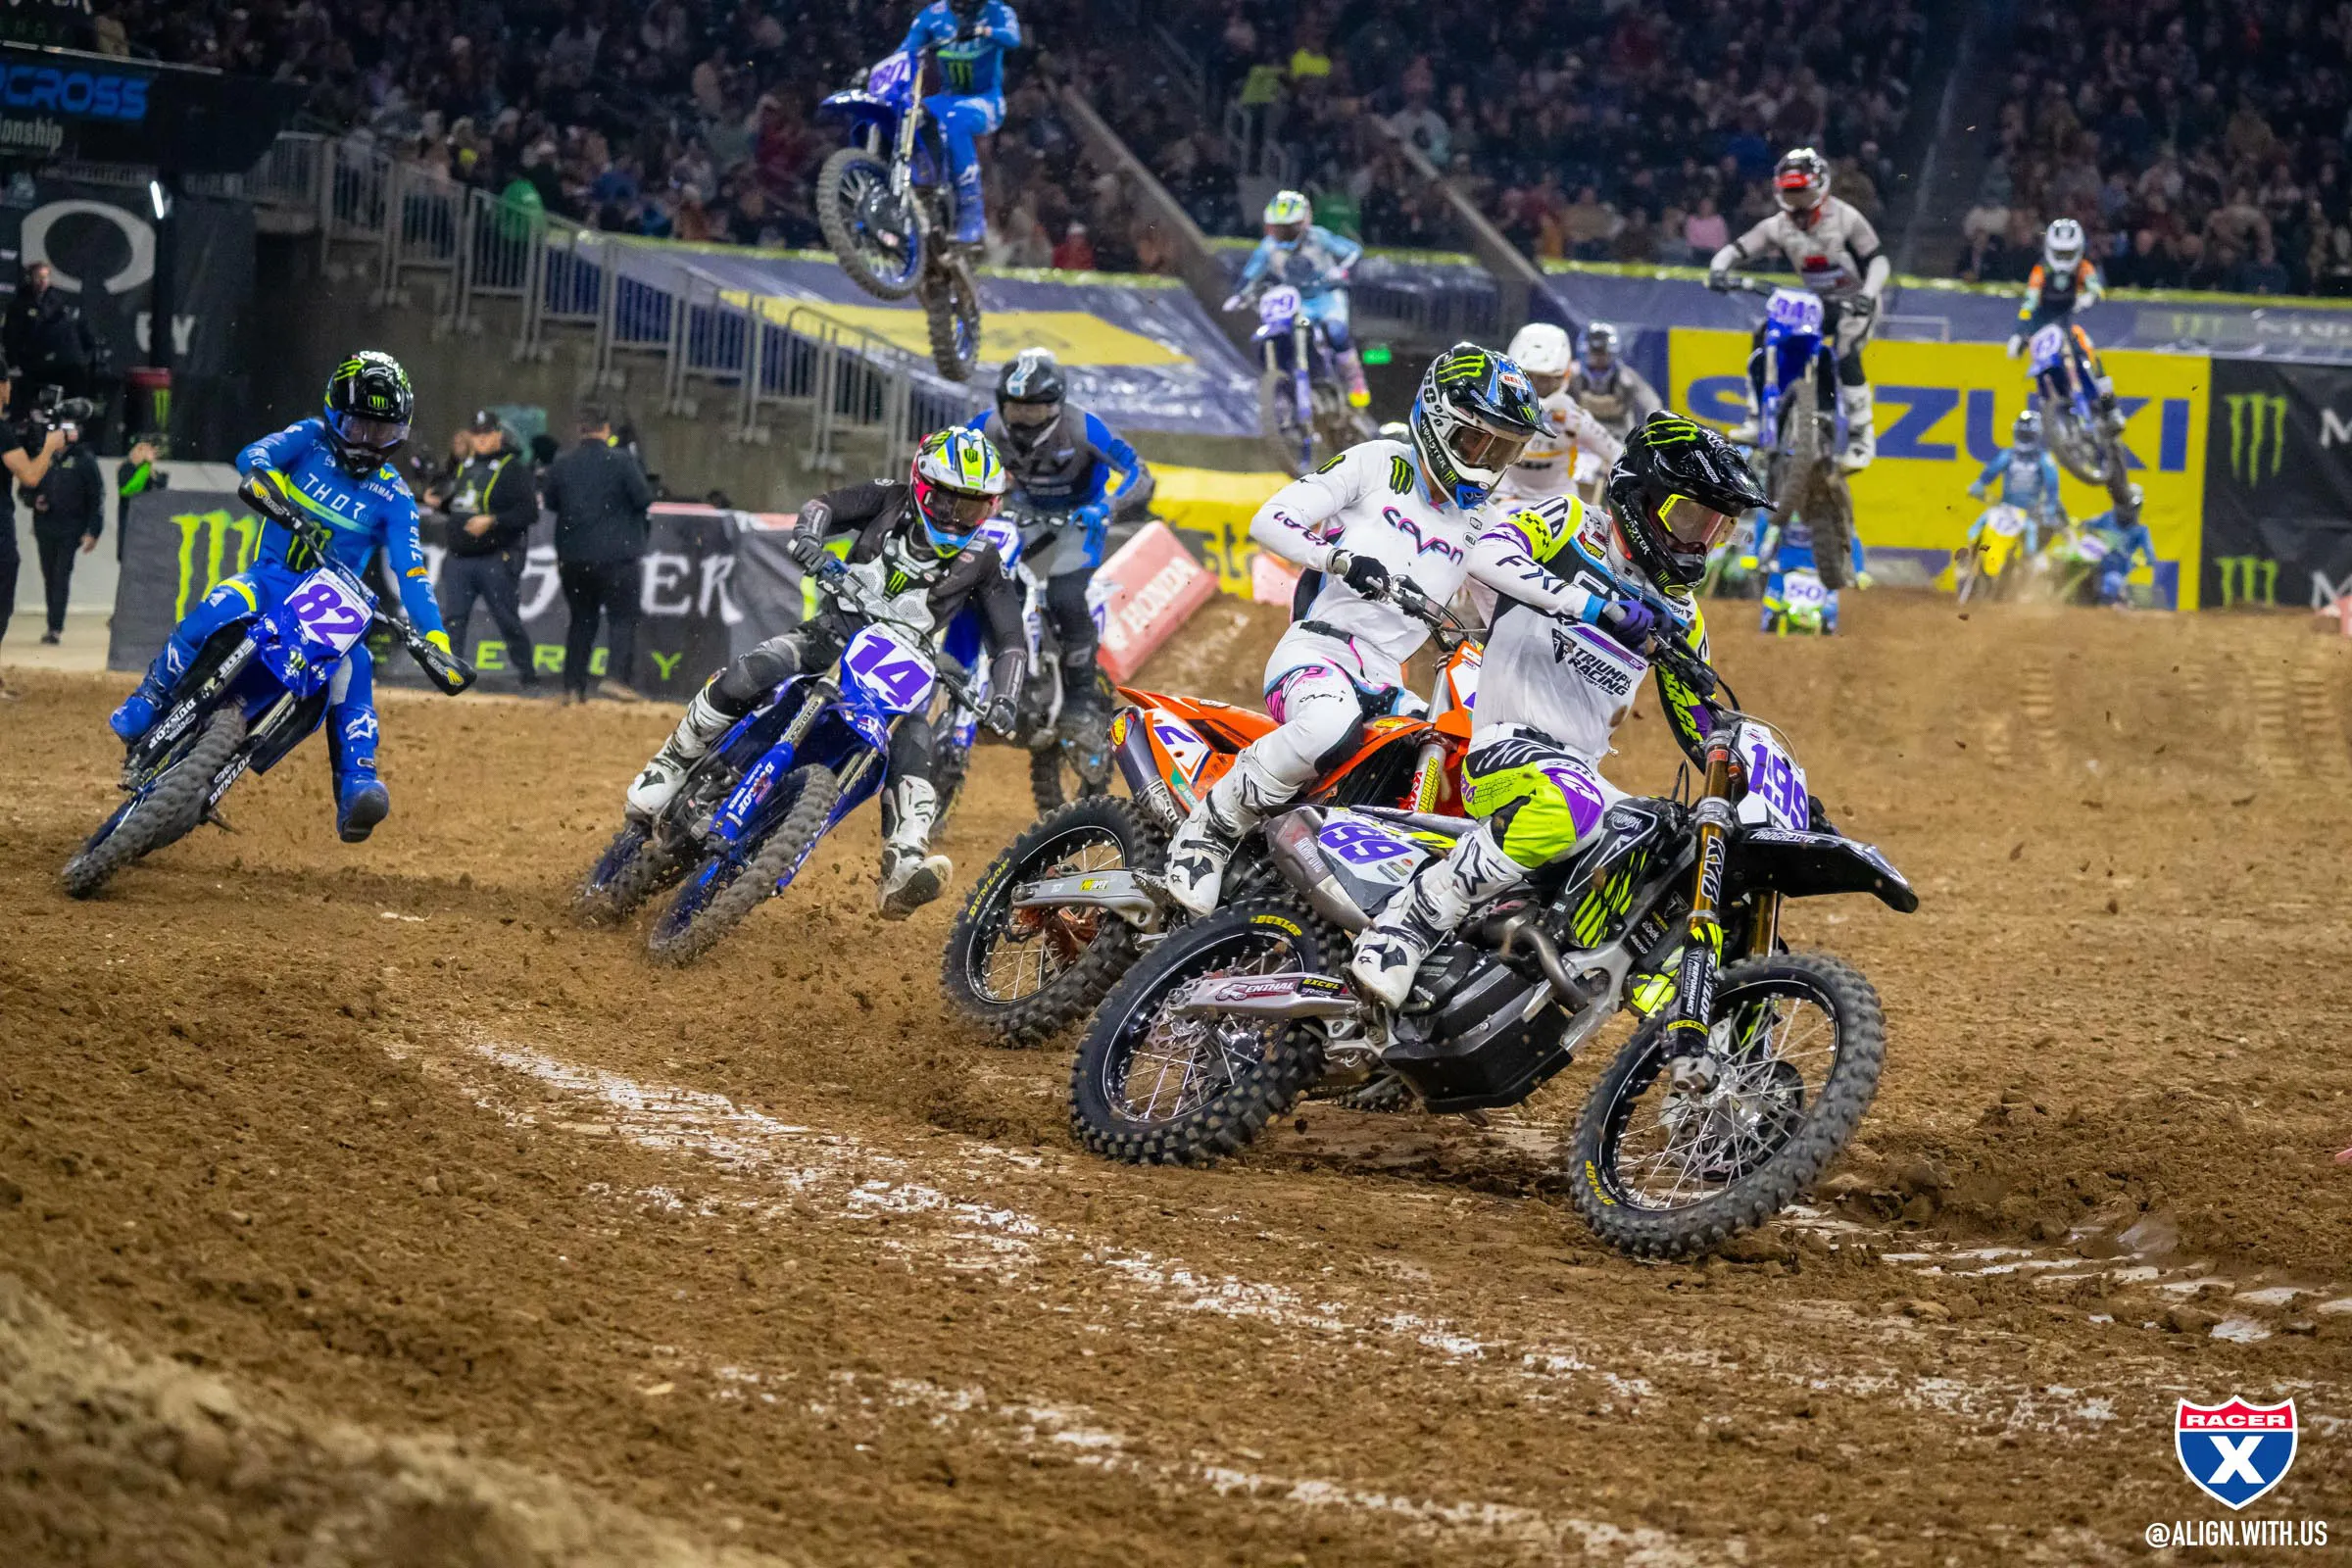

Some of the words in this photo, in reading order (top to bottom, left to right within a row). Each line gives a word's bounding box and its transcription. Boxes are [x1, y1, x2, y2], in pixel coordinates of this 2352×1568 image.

[0, 64, 148, 120] CROSS
[0, 112, 63, 155] onship
[1503, 374, 1524, 387] BELL
[1688, 373, 2189, 472] SZUKI
[290, 583, 366, 648] 82
[850, 634, 932, 709] 14
[1568, 658, 1630, 697] RACING
[1573, 647, 1633, 689] TRIUMPH
[149, 697, 196, 750] DUNLOP
[1748, 743, 1809, 831] 199
[1607, 811, 1644, 829] TRIUMPH
[968, 858, 1010, 917] DUNLOP
[1701, 835, 1726, 906] KYB
[1254, 914, 1302, 937] DUNLOP
[1302, 978, 1341, 990] EXCEL
[1686, 960, 1700, 1015] PERFORMANCE
[1700, 952, 1717, 1026] DUNLOP
[1585, 1159, 1618, 1206] DUNLOP
